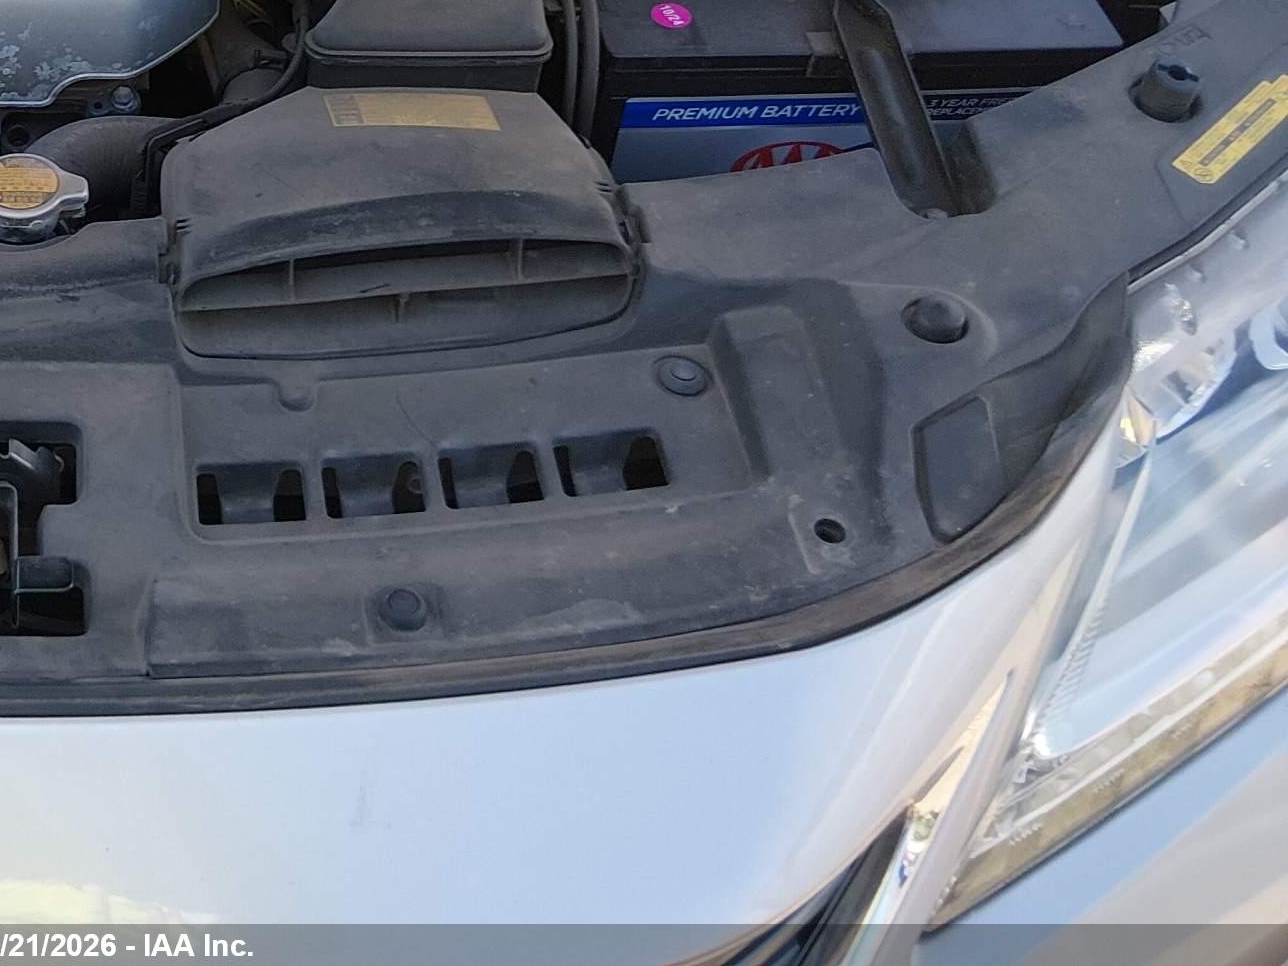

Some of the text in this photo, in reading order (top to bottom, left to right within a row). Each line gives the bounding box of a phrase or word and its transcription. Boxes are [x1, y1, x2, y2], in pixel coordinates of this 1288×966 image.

[659, 4, 685, 26] 10/24
[927, 99, 940, 107] 3
[940, 98, 979, 107] YEAR
[651, 104, 861, 121] PREMIUM BATTERY
